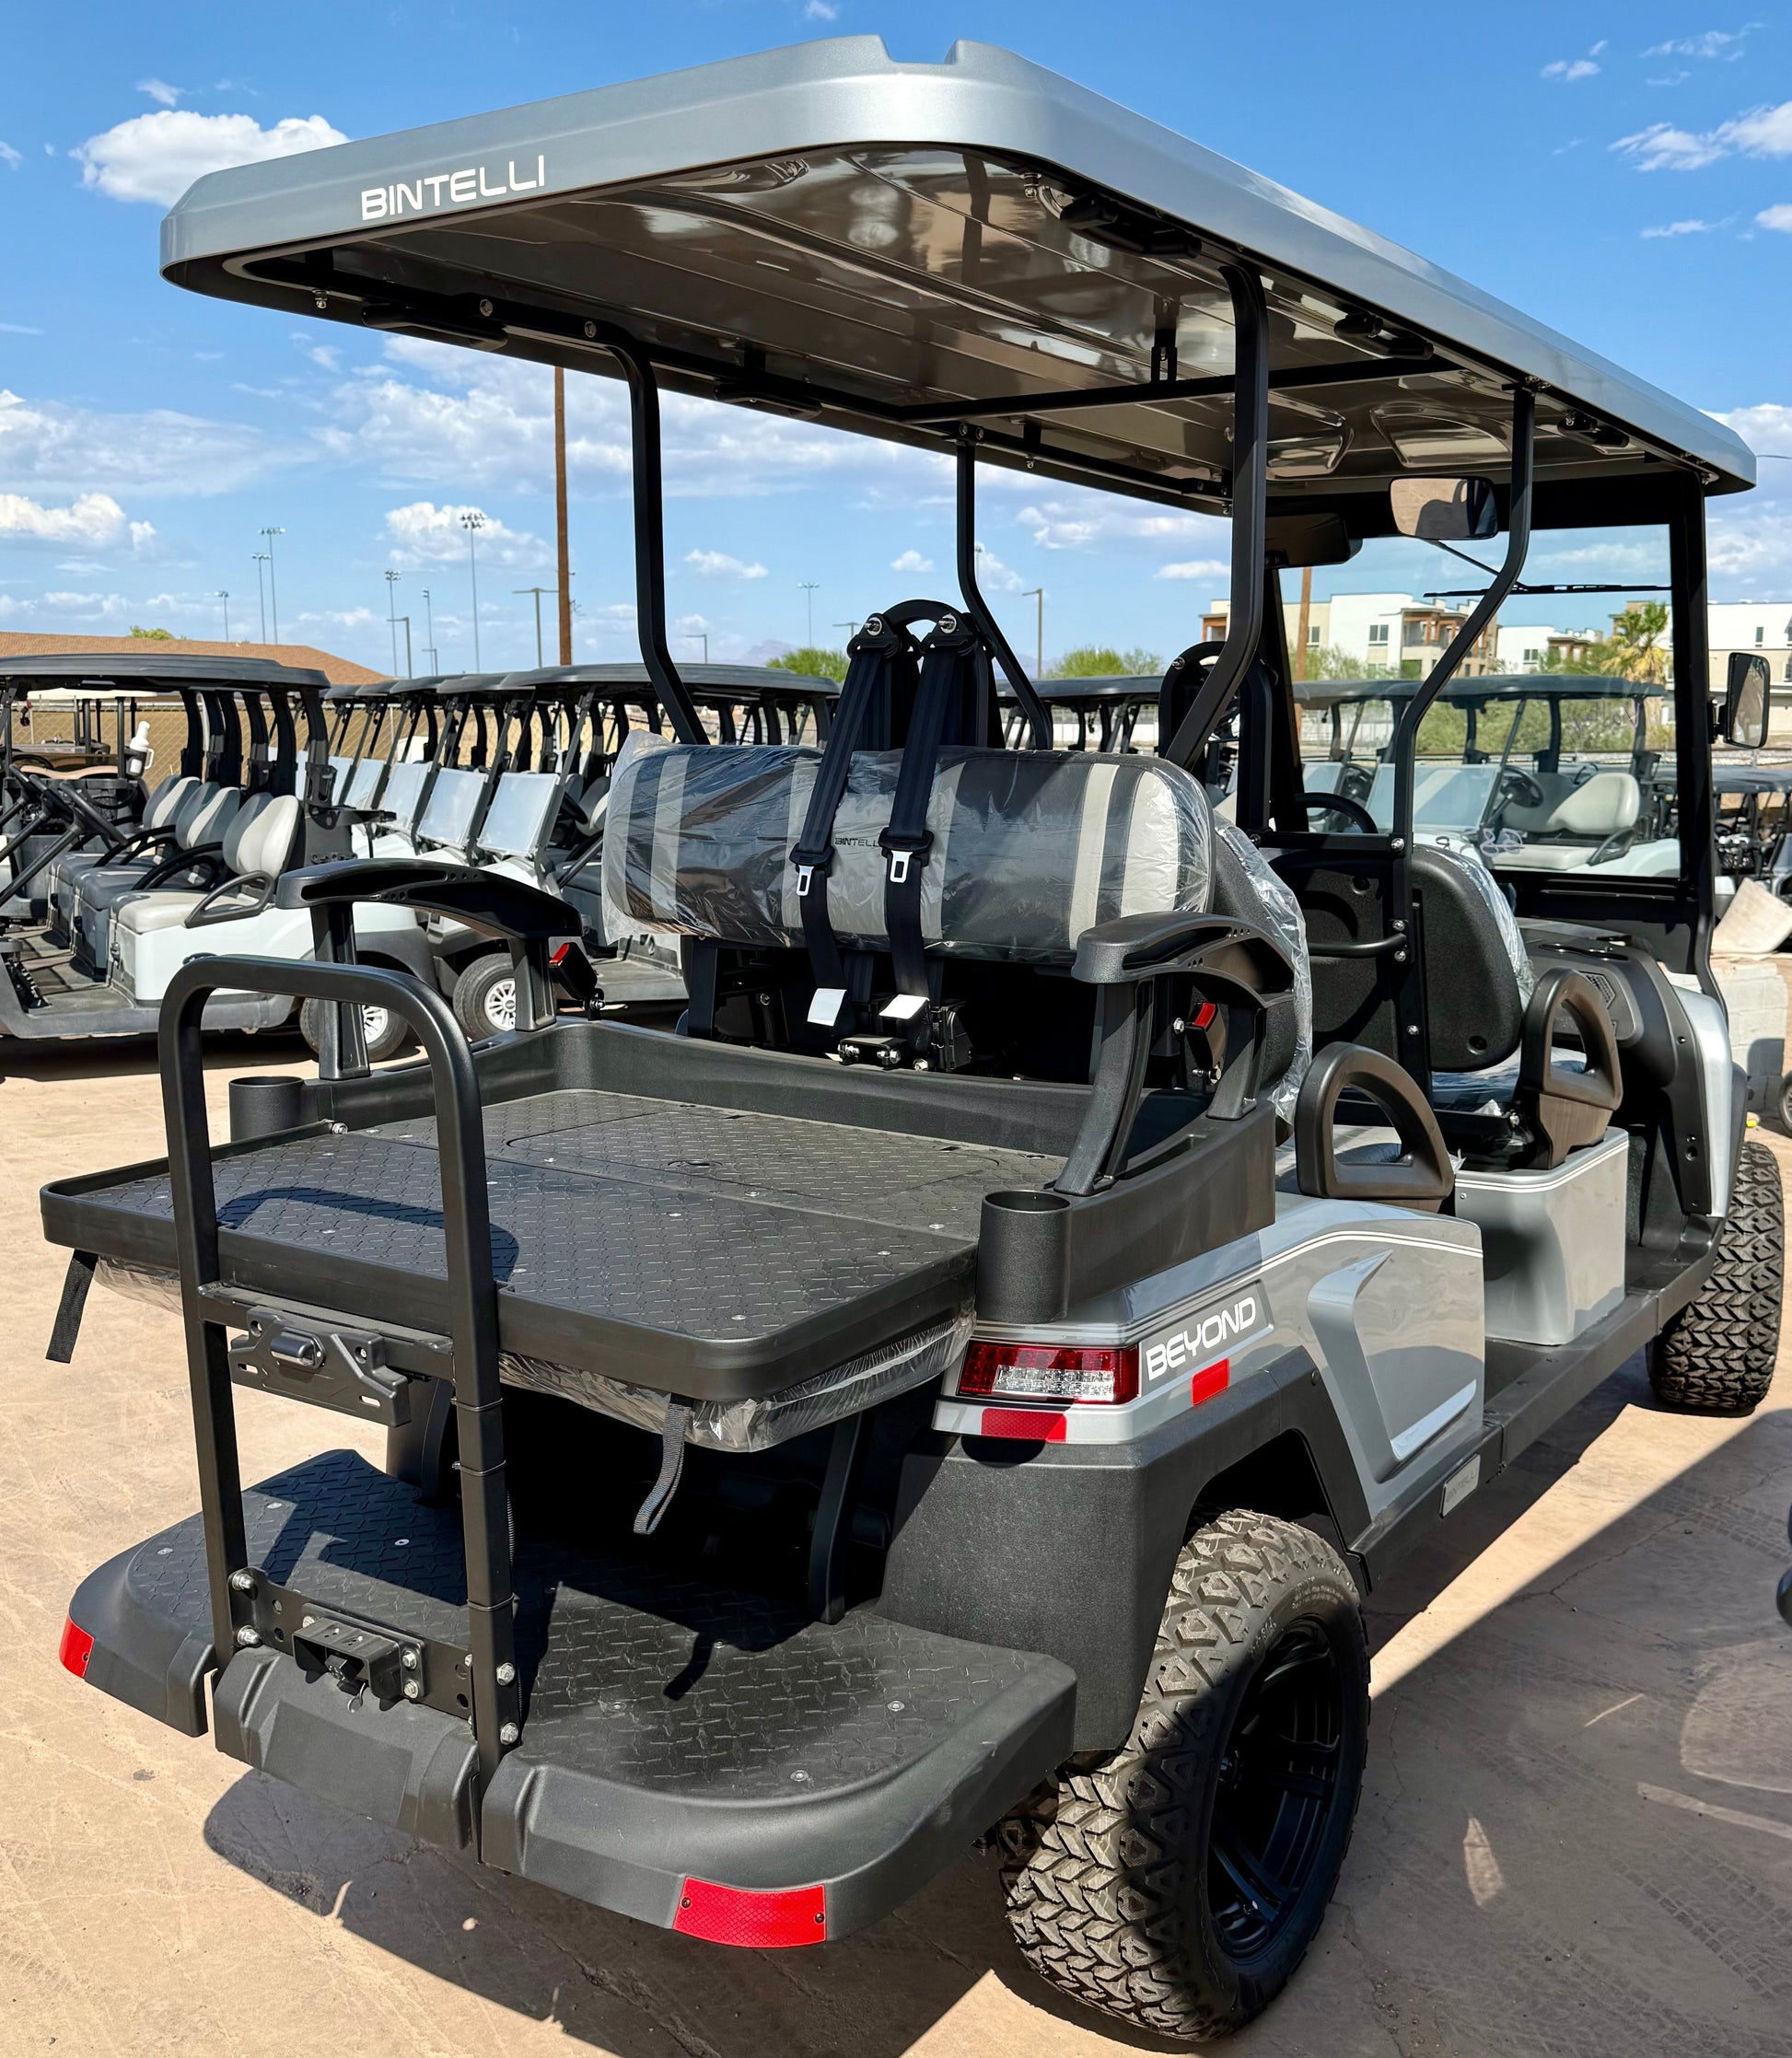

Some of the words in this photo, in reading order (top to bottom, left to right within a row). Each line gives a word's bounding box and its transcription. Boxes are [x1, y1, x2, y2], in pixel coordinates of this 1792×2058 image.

[361, 155, 545, 221] BINTELLI
[834, 837, 879, 847] BINTELL
[1146, 1296, 1256, 1380] BEYOND
